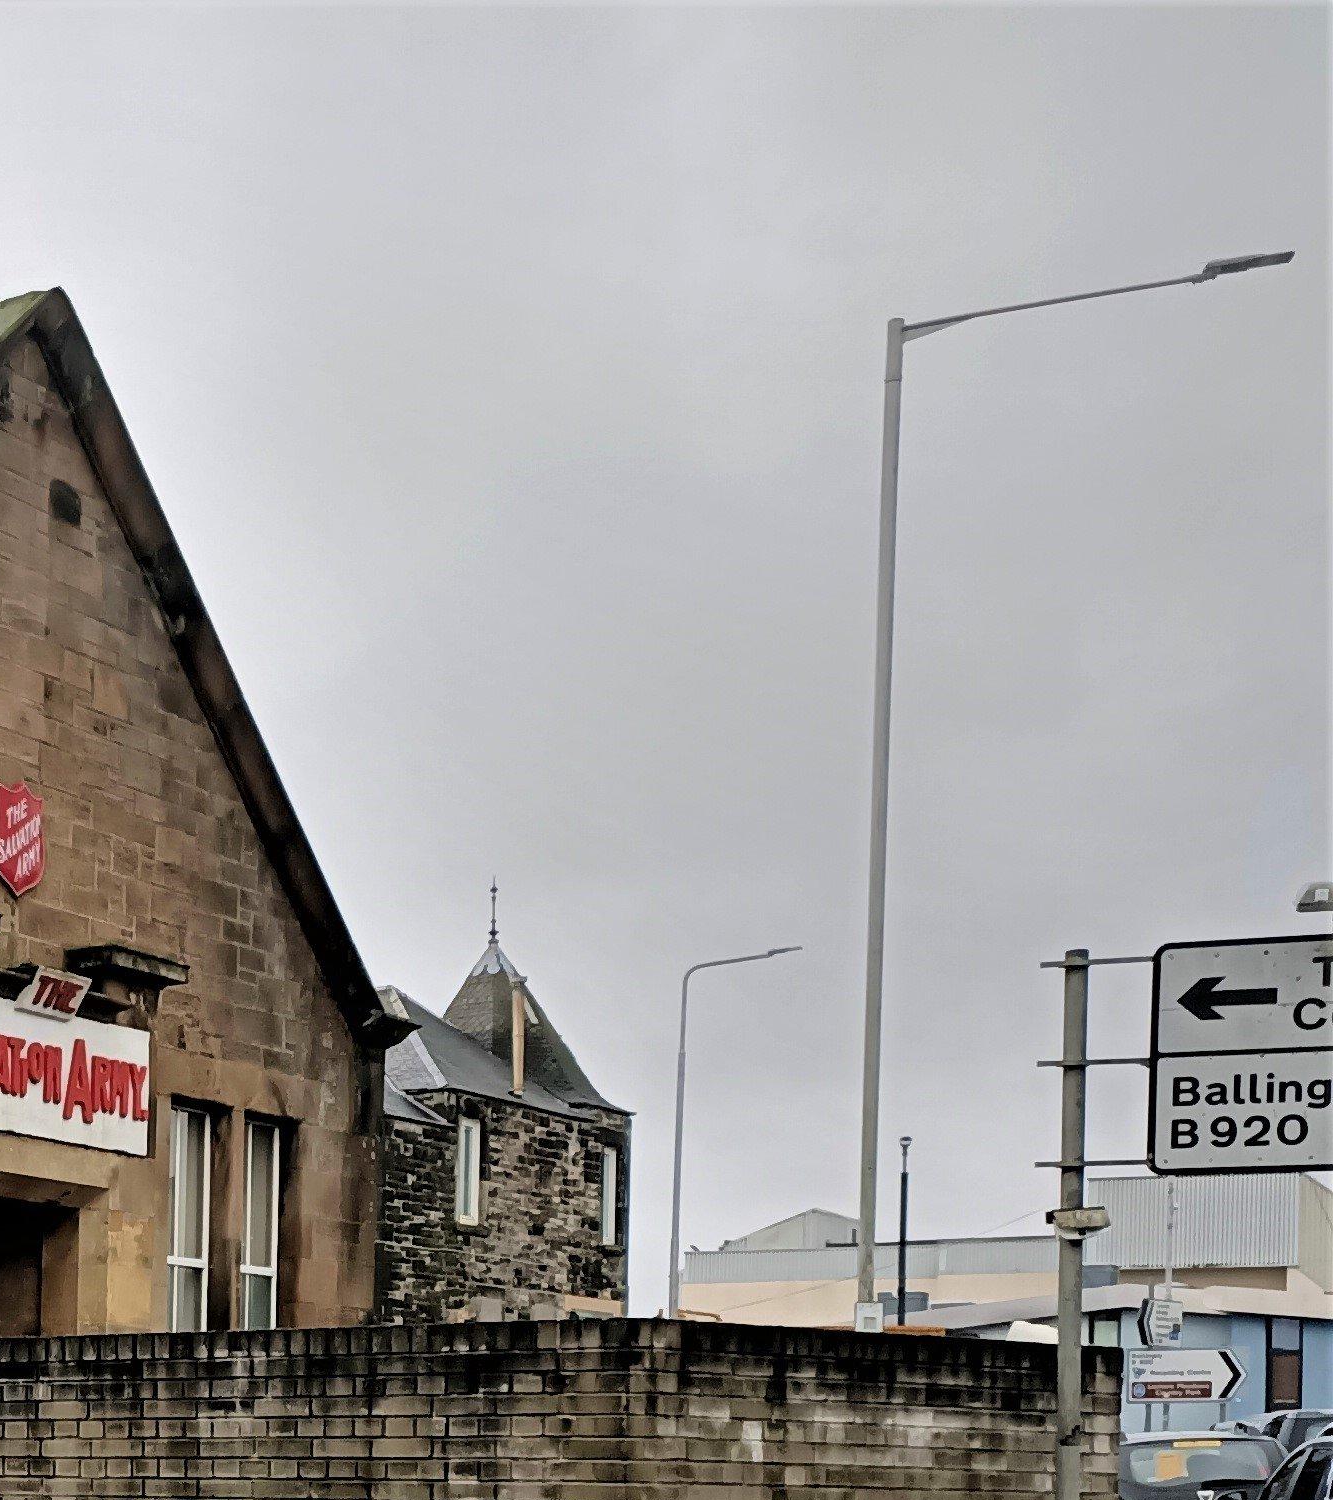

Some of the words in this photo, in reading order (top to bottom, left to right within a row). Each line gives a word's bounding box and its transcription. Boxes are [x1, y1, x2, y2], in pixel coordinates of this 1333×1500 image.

[6, 797, 29, 829] THE
[13, 837, 41, 883] ARMY
[32, 974, 84, 1014] THE
[1292, 997, 1333, 1030] C
